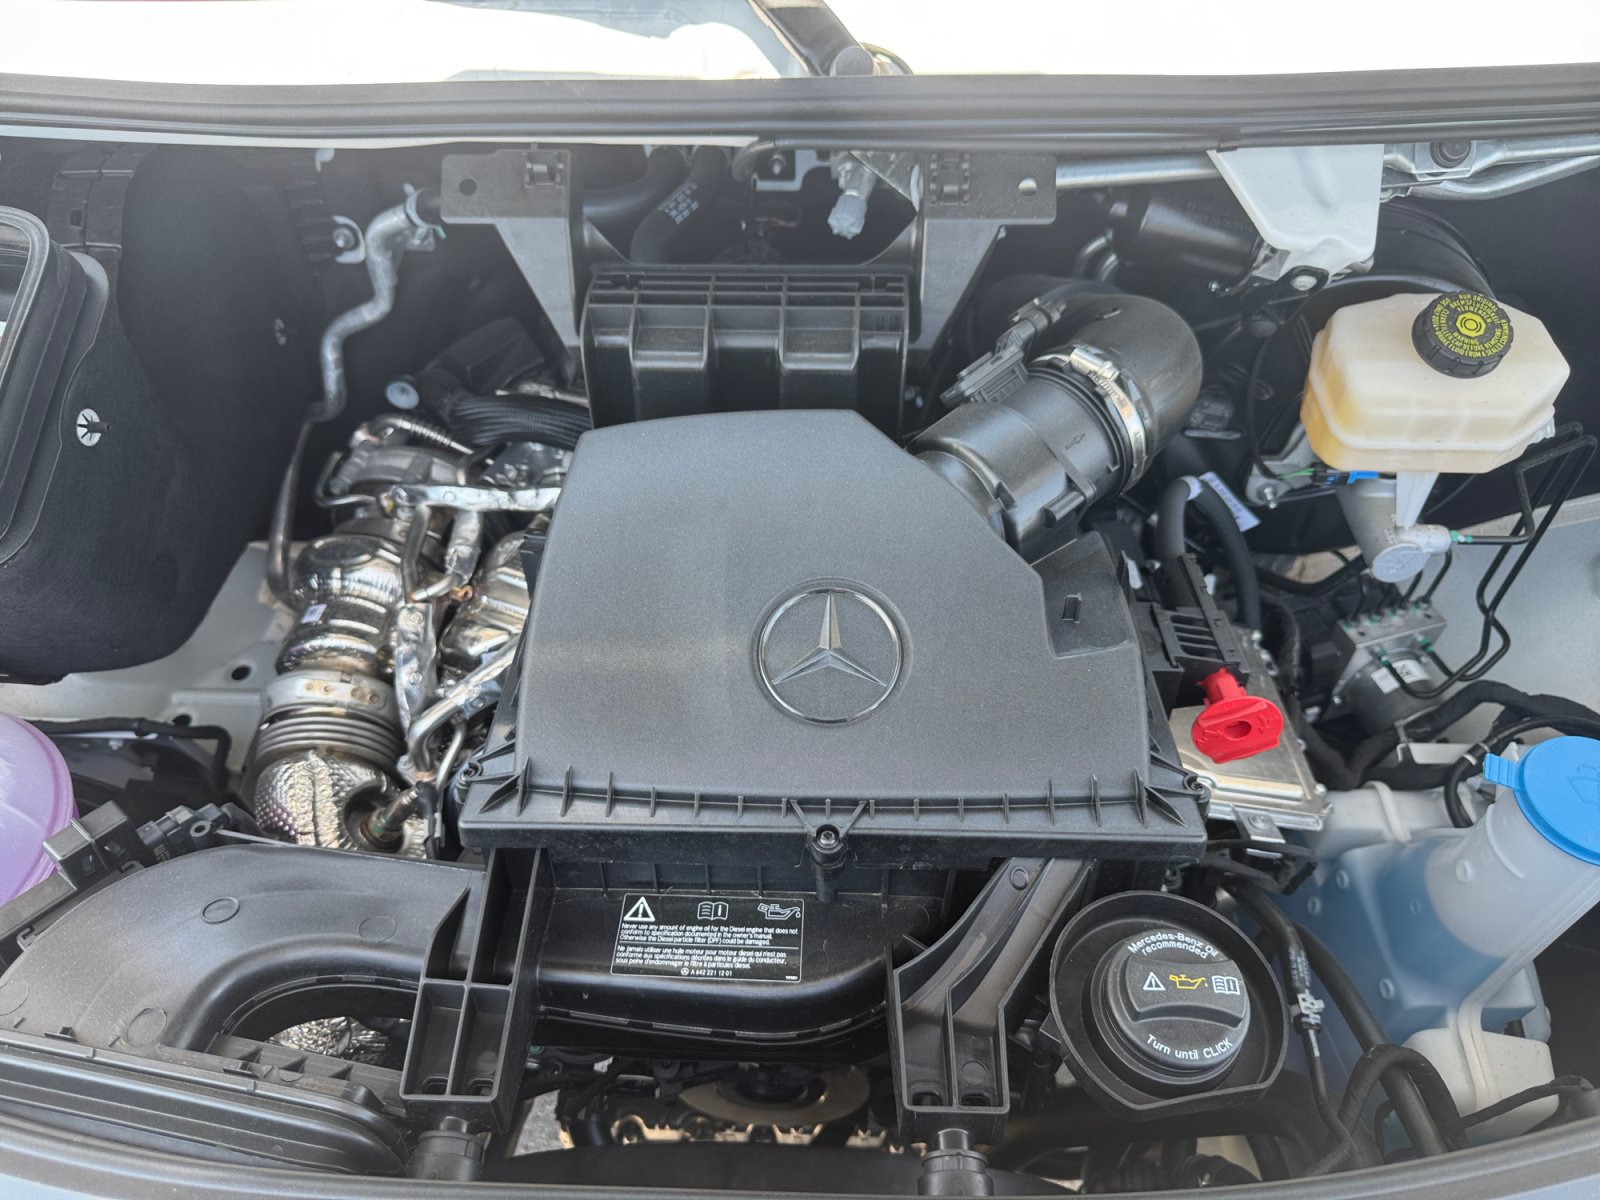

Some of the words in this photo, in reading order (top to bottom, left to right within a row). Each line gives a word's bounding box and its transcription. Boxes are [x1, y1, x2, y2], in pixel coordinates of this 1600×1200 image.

[1128, 932, 1202, 953] Mercedes-Benz
[1206, 944, 1218, 957] Oil
[1142, 941, 1208, 959] recommended
[1146, 1034, 1172, 1055] Turn
[1175, 1049, 1198, 1060] until
[1203, 1038, 1233, 1058] CLICK
